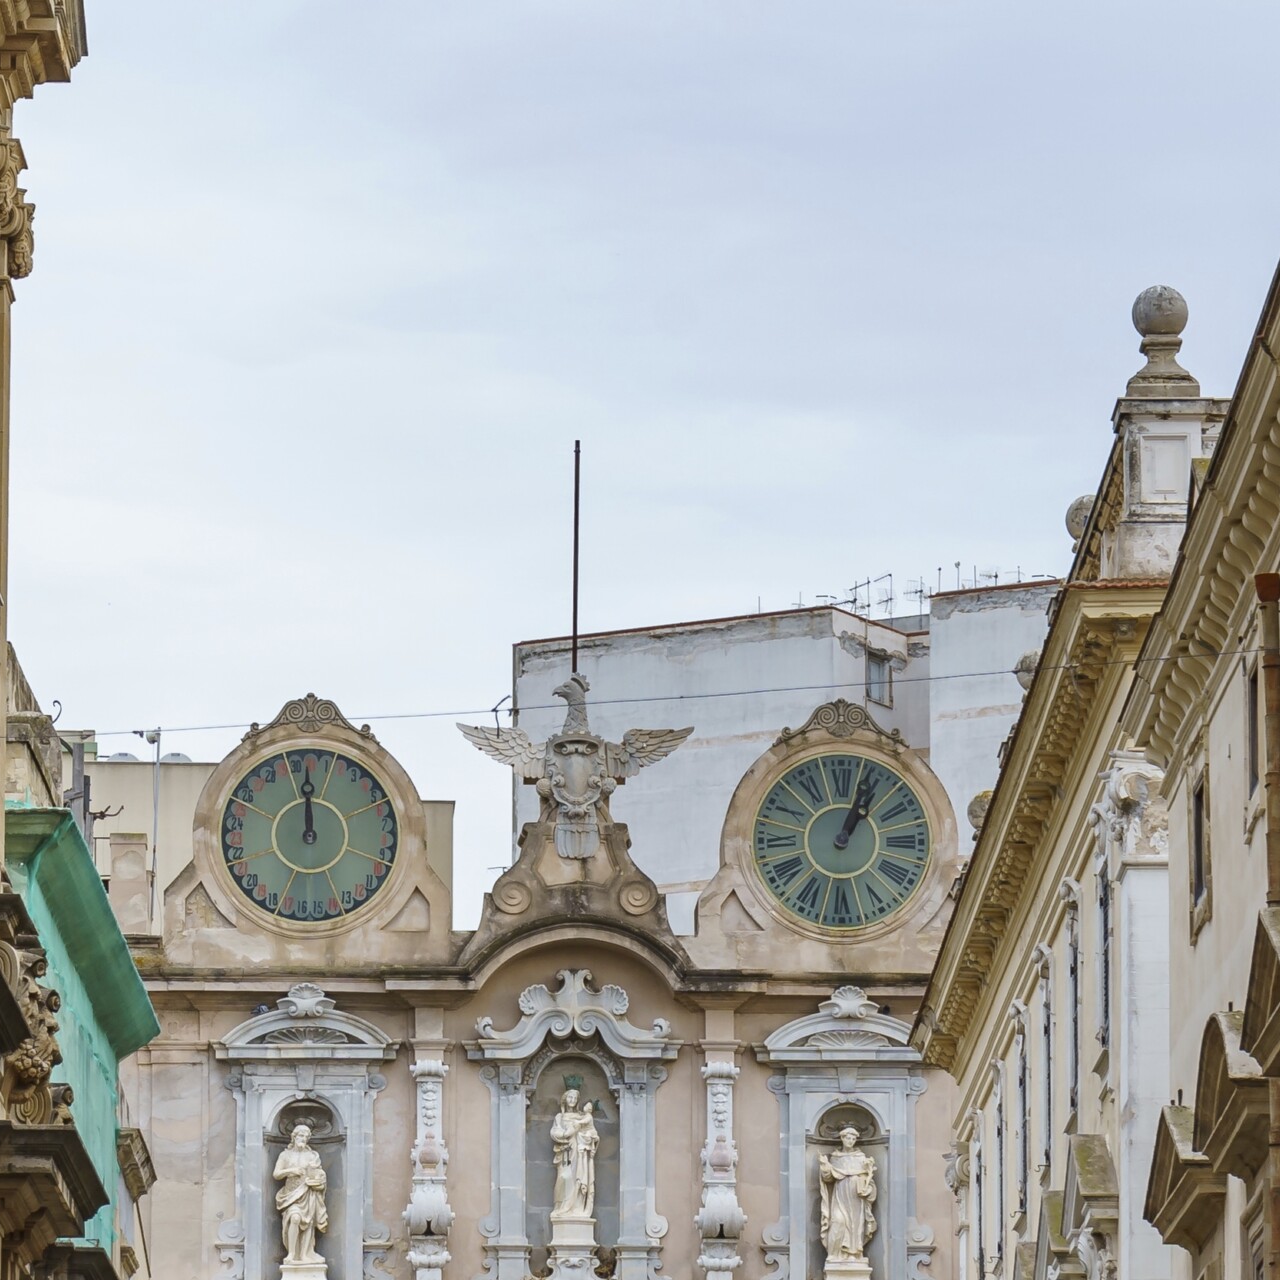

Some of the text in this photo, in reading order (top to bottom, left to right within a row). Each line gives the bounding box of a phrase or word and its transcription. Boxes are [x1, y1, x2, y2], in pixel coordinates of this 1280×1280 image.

[291, 760, 301, 774] 30
[265, 770, 276, 783] 28
[351, 769, 357, 782] 3
[832, 768, 851, 798] XII
[242, 790, 253, 803] 26
[799, 774, 824, 806] XI
[371, 791, 377, 803] 5
[231, 817, 243, 830] 24
[382, 819, 387, 831] 7
[230, 832, 242, 845] 23
[233, 847, 244, 859] 22
[247, 874, 258, 887] 20
[366, 875, 373, 888] 11
[355, 884, 364, 897] 12
[268, 893, 278, 907] 18
[342, 891, 351, 904] 13
[297, 900, 307, 914] 16
[313, 901, 323, 914] 15
